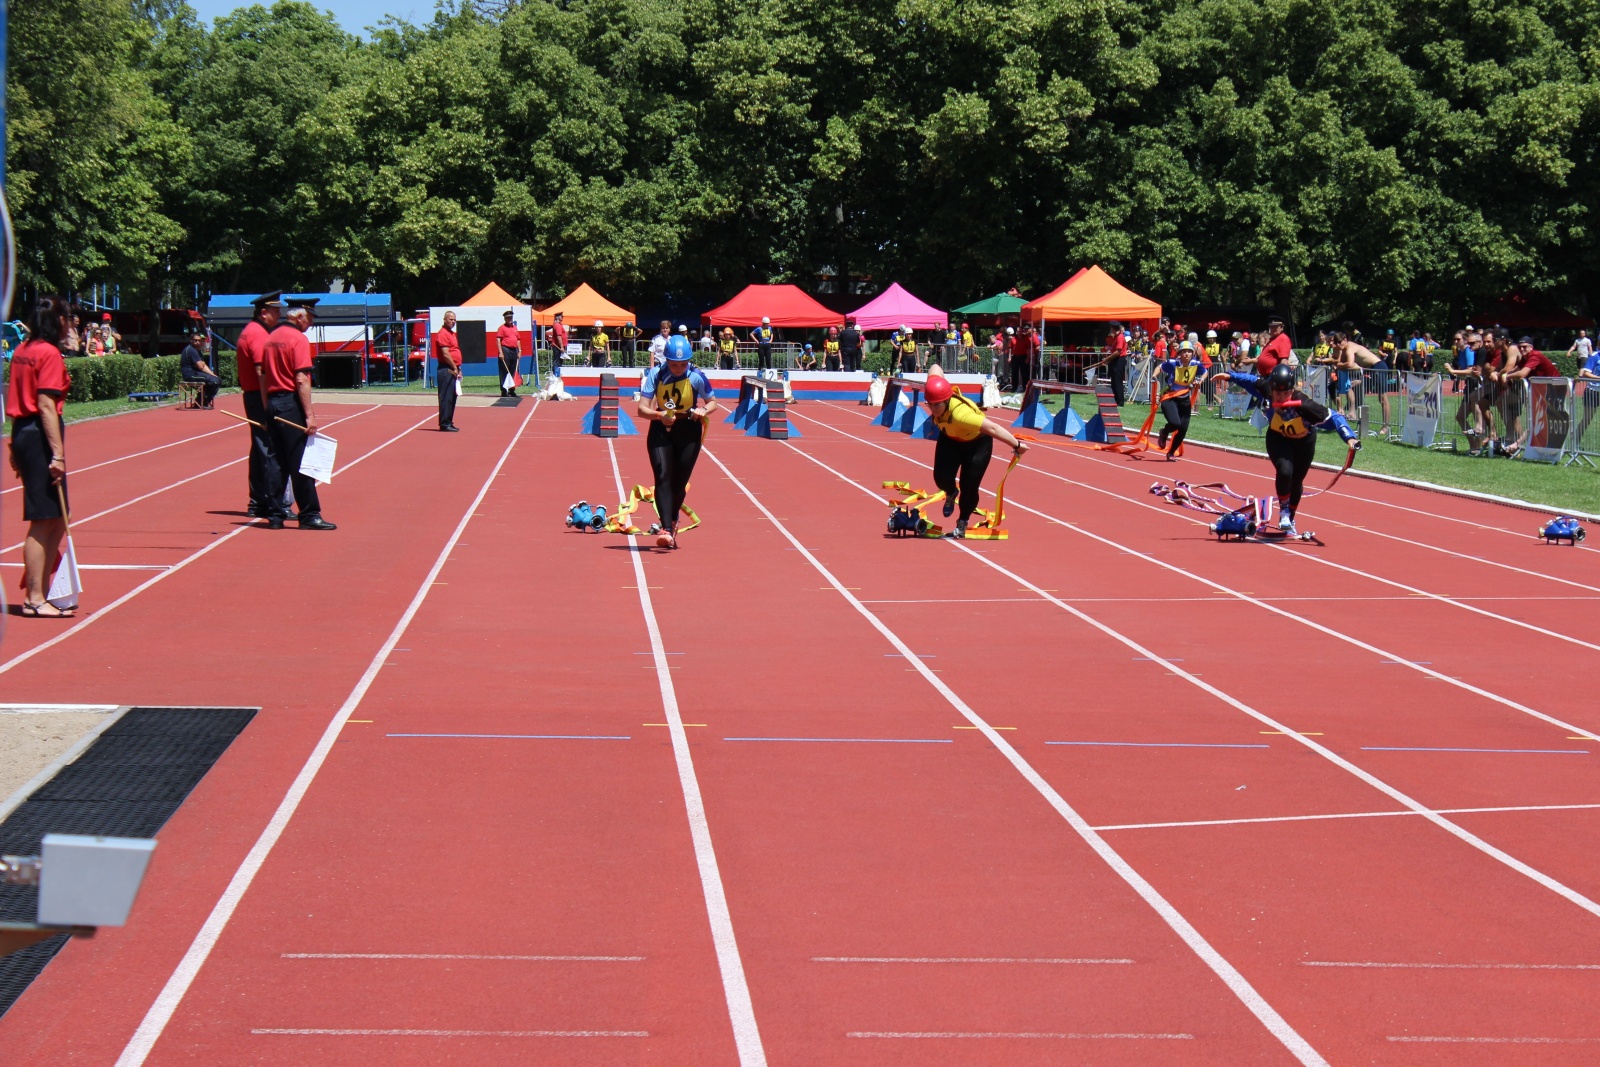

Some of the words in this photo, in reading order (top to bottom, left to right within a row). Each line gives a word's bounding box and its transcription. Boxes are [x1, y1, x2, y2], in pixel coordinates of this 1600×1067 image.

[1183, 369, 1190, 383] 9
[663, 386, 684, 410] 12
[1279, 424, 1297, 435] 10
